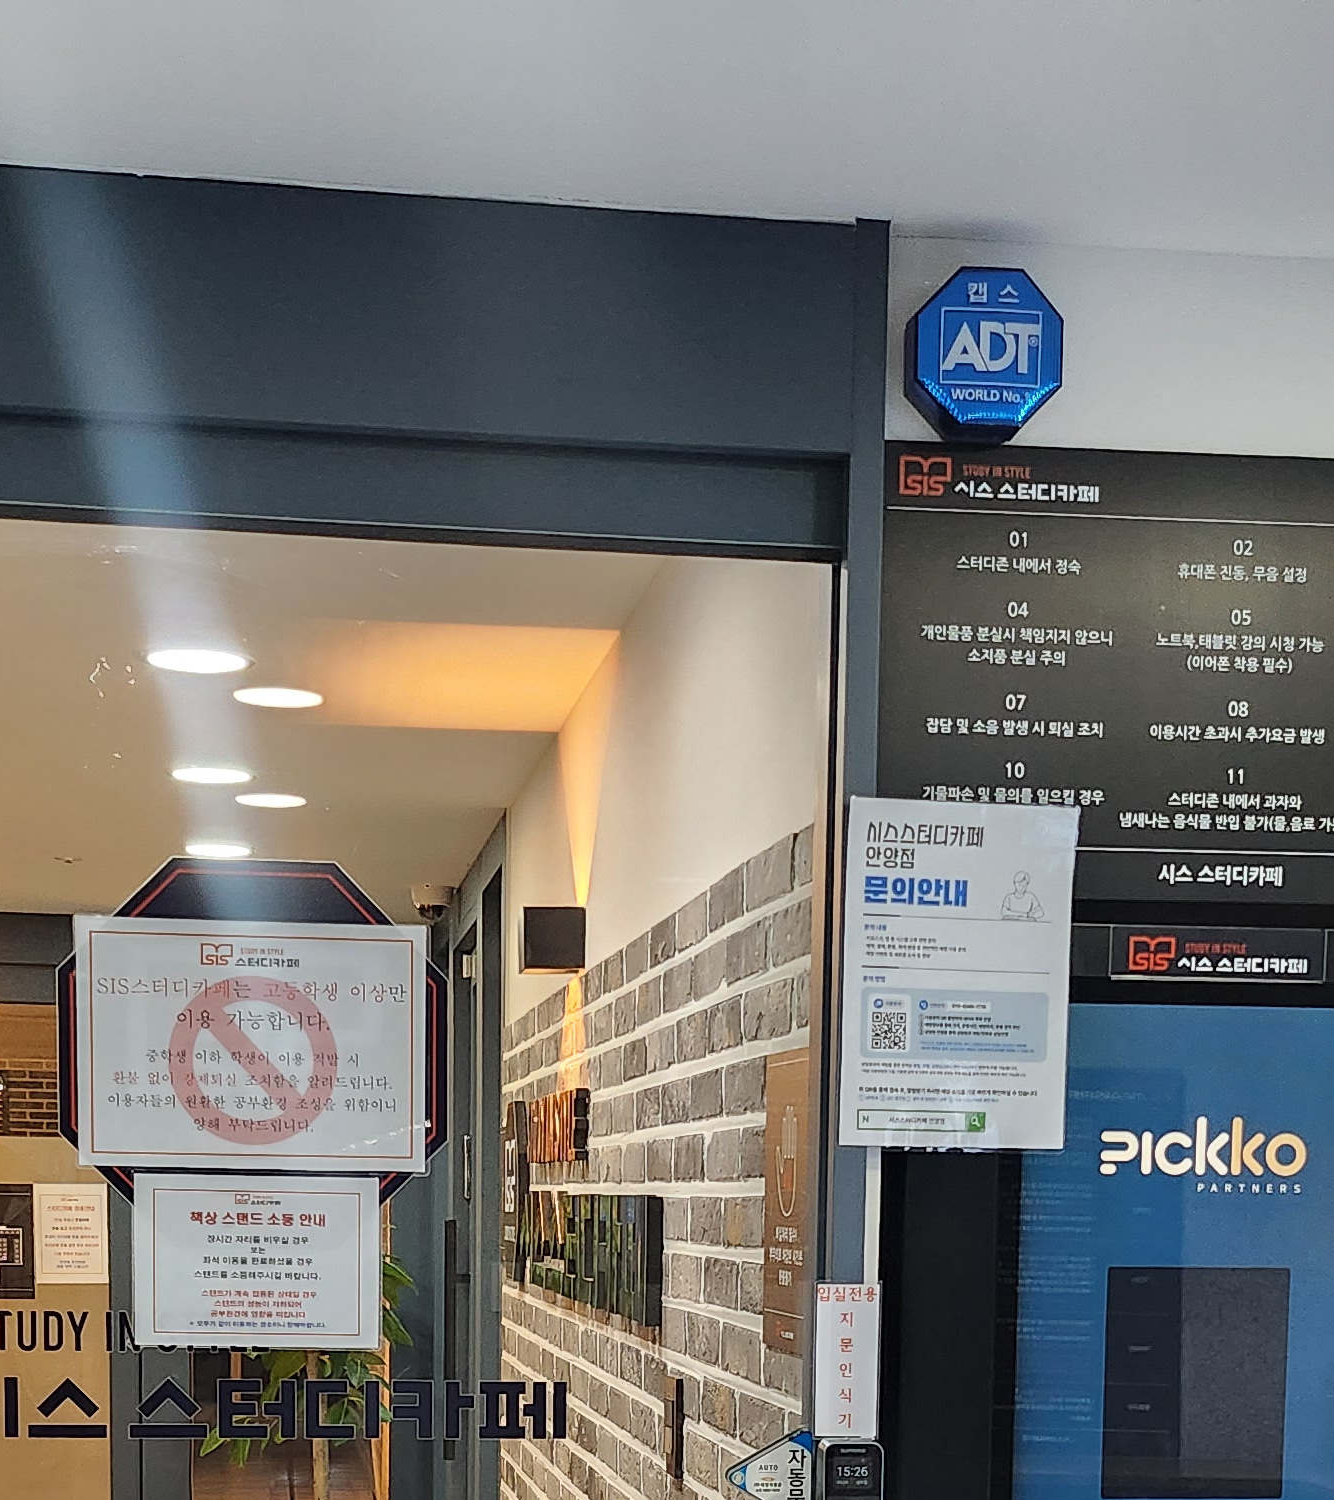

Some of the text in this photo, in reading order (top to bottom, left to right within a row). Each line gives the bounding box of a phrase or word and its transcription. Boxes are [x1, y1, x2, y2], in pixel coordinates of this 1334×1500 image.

[942, 321, 1039, 374] ADT
[951, 388, 1000, 401] WORLD
[954, 480, 1100, 502] 시스 스터디카페
[1009, 531, 1028, 548] 01
[1233, 540, 1253, 556] 02
[956, 556, 1081, 575] 스터디존 내에서 정숙
[1178, 563, 1307, 583] 휴대폰 진동, 무음 설정
[1228, 701, 1249, 717] 08
[1150, 724, 1325, 744] 이용시간 초과시 추가요금 발생
[867, 822, 984, 848] 시스스터디카페
[865, 846, 915, 869] 안양점
[1158, 864, 1283, 887] 시스 스터디카페
[864, 876, 968, 907] 문의안내
[235, 957, 300, 969] 스터디카페
[1178, 956, 1308, 974] 시스 스터디카페
[97, 977, 407, 1004] SIS스터디카페는 고등학생 이상만
[177, 1009, 330, 1032] 이용 가능합니다.
[1197, 1183, 1301, 1194] PARTNERS
[190, 1212, 326, 1227] 책상 스탠드 소등 안내
[817, 1286, 878, 1303] 입실전용
[128, 1376, 568, 1441] 스터디카페
[758, 1464, 779, 1472] AUTO
[836, 1465, 869, 1478] 15:26
